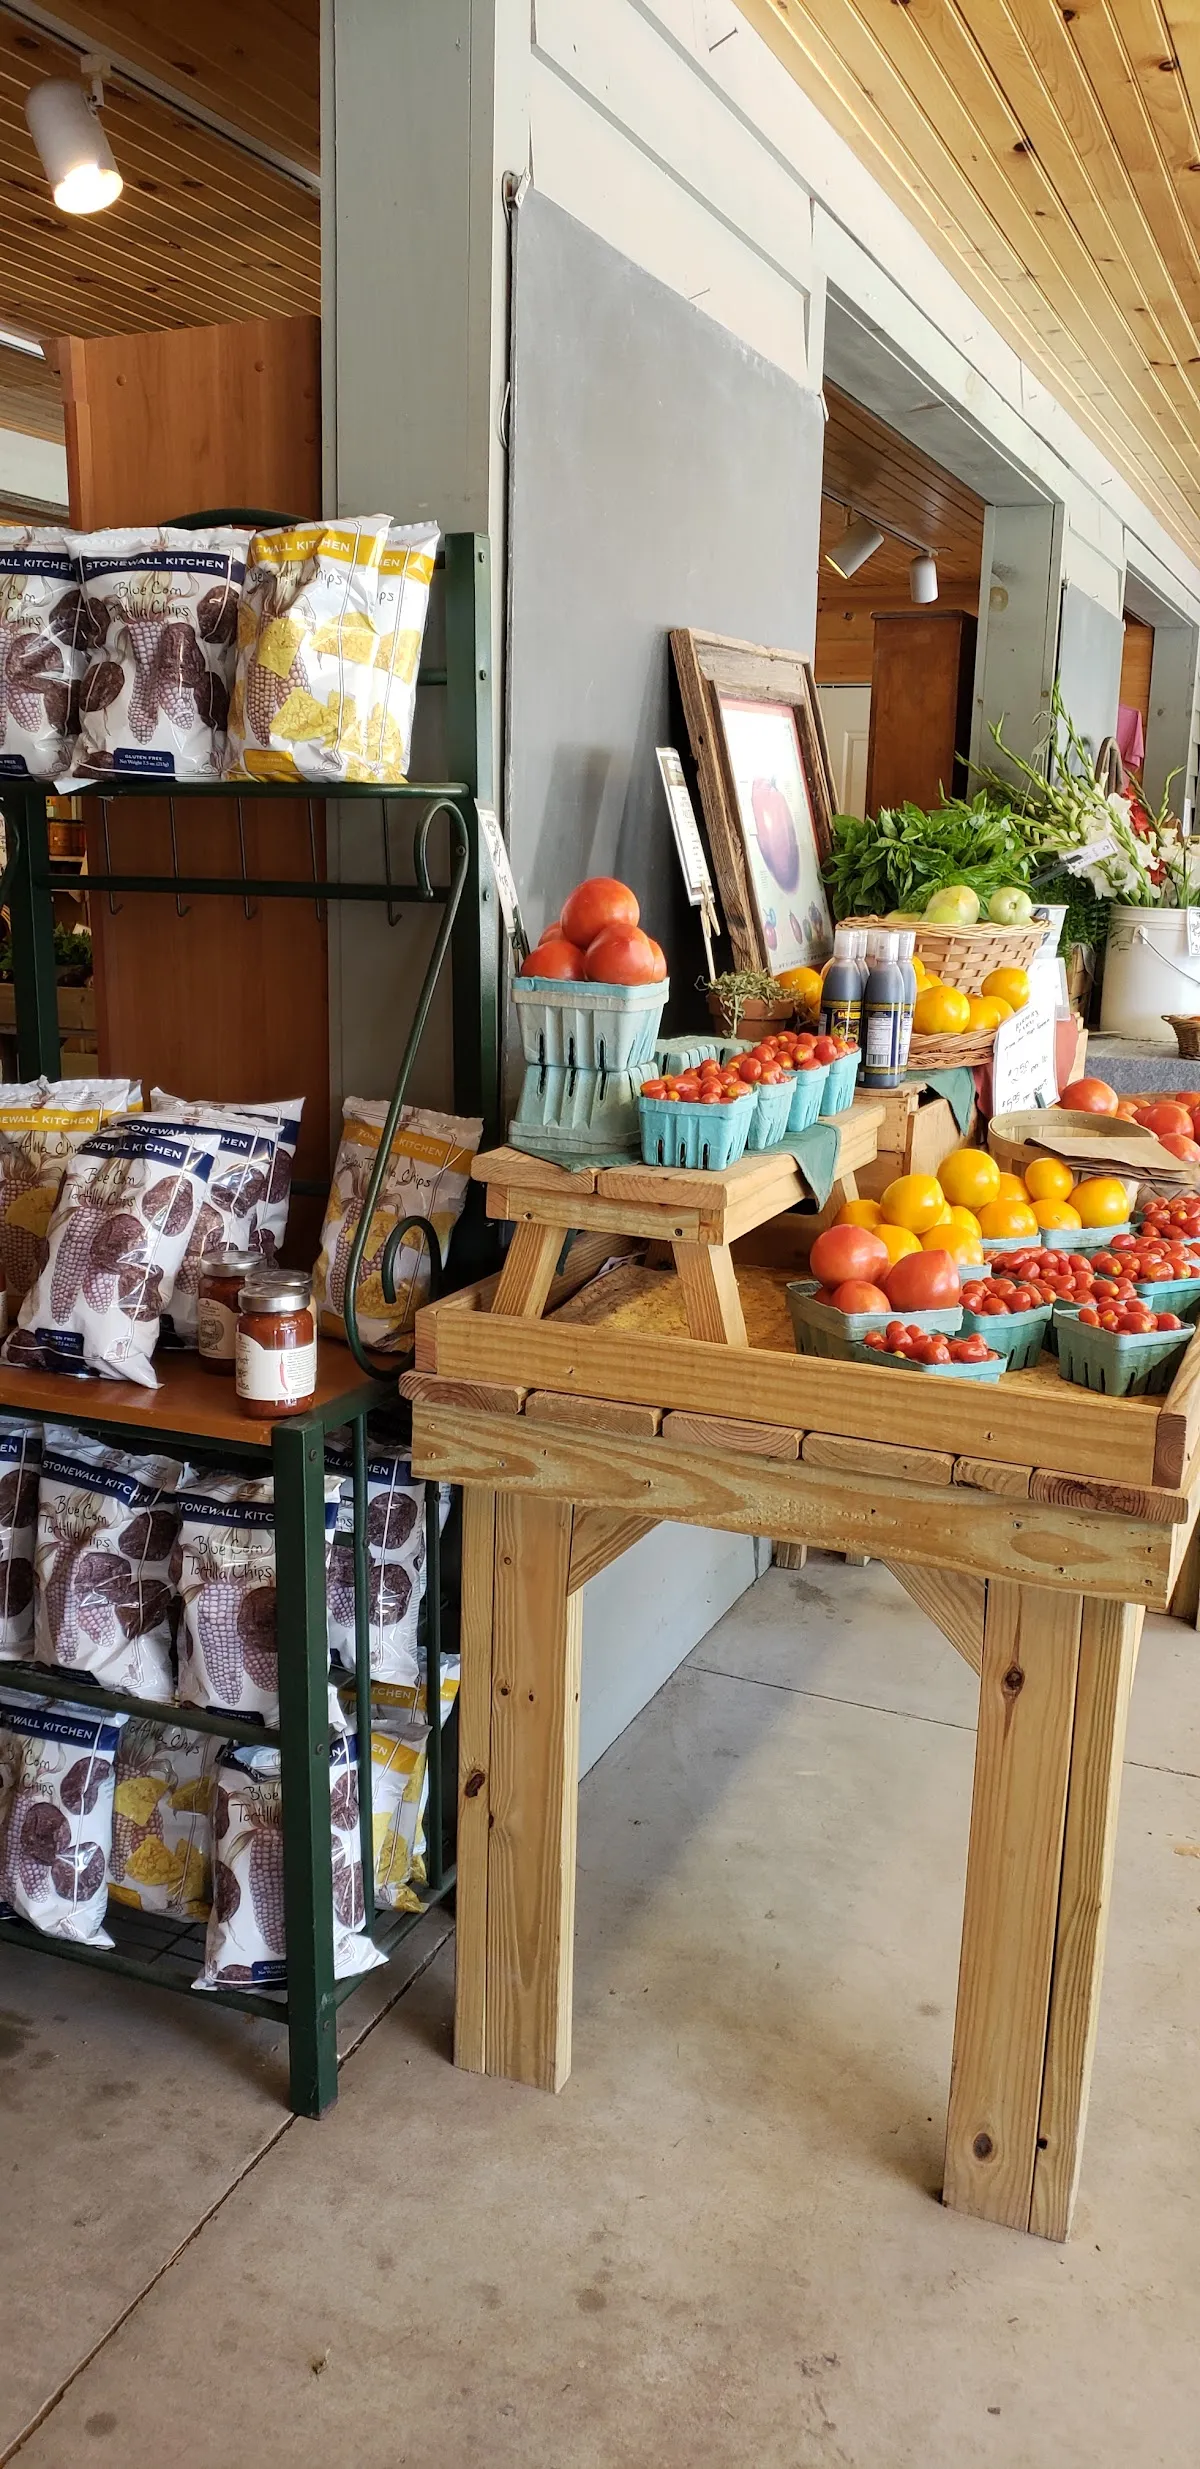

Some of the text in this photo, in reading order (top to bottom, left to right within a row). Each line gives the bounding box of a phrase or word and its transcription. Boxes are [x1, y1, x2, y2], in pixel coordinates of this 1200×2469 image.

[296, 538, 350, 553] KITHEN
[84, 557, 224, 571] STONEWALL KITCHEN
[112, 581, 147, 599] Blue
[151, 600, 190, 618] Chips
[42, 1115, 94, 1126] KITCHEN
[126, 1124, 188, 1136] TONEWALL
[399, 1138, 444, 1157] KITCHEN
[402, 1169, 431, 1190] Chips
[42, 1460, 103, 1484] STONEWALL
[53, 1495, 80, 1518] Blue
[179, 1501, 275, 1522] TONEWALL KITC
[40, 1514, 80, 1541] Tortilla
[193, 1535, 225, 1555] Blue
[185, 1555, 273, 1582] Tortilla Chips
[43, 1722, 93, 1740] KITCHEN
[171, 1734, 200, 1756] Chips
[243, 1786, 279, 1801] Blue
[231, 1803, 280, 1824] Tortilla
